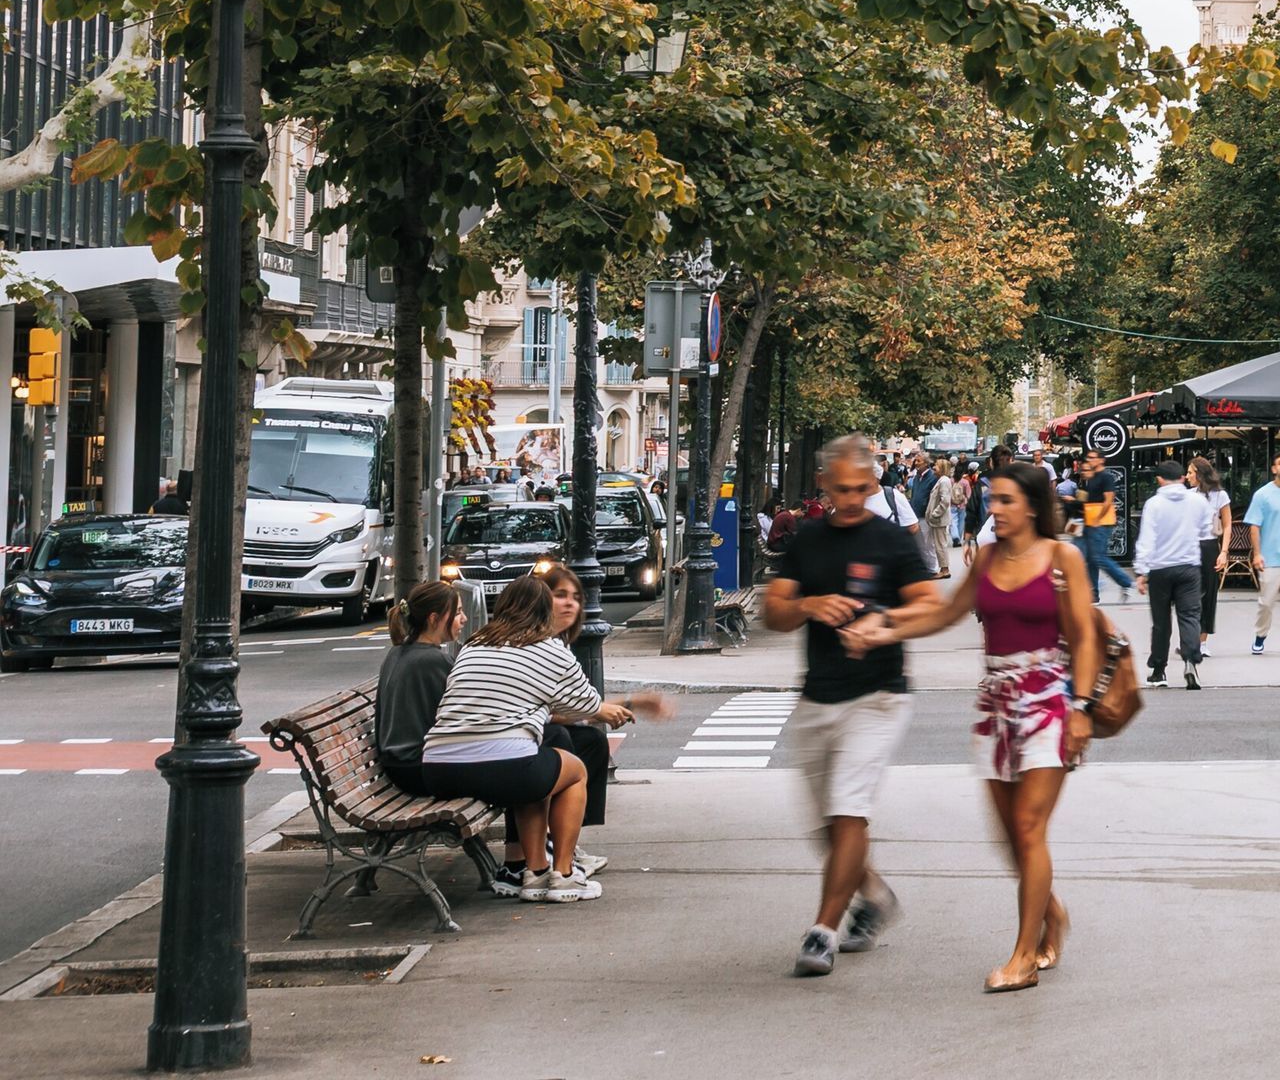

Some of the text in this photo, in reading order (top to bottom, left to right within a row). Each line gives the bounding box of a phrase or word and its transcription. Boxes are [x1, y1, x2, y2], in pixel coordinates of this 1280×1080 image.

[467, 496, 481, 504] TAXI
[68, 502, 86, 512] TAXI
[256, 526, 299, 536] IVECO
[253, 581, 292, 589] 8029 MRX
[78, 621, 130, 631] 8443 MKG
